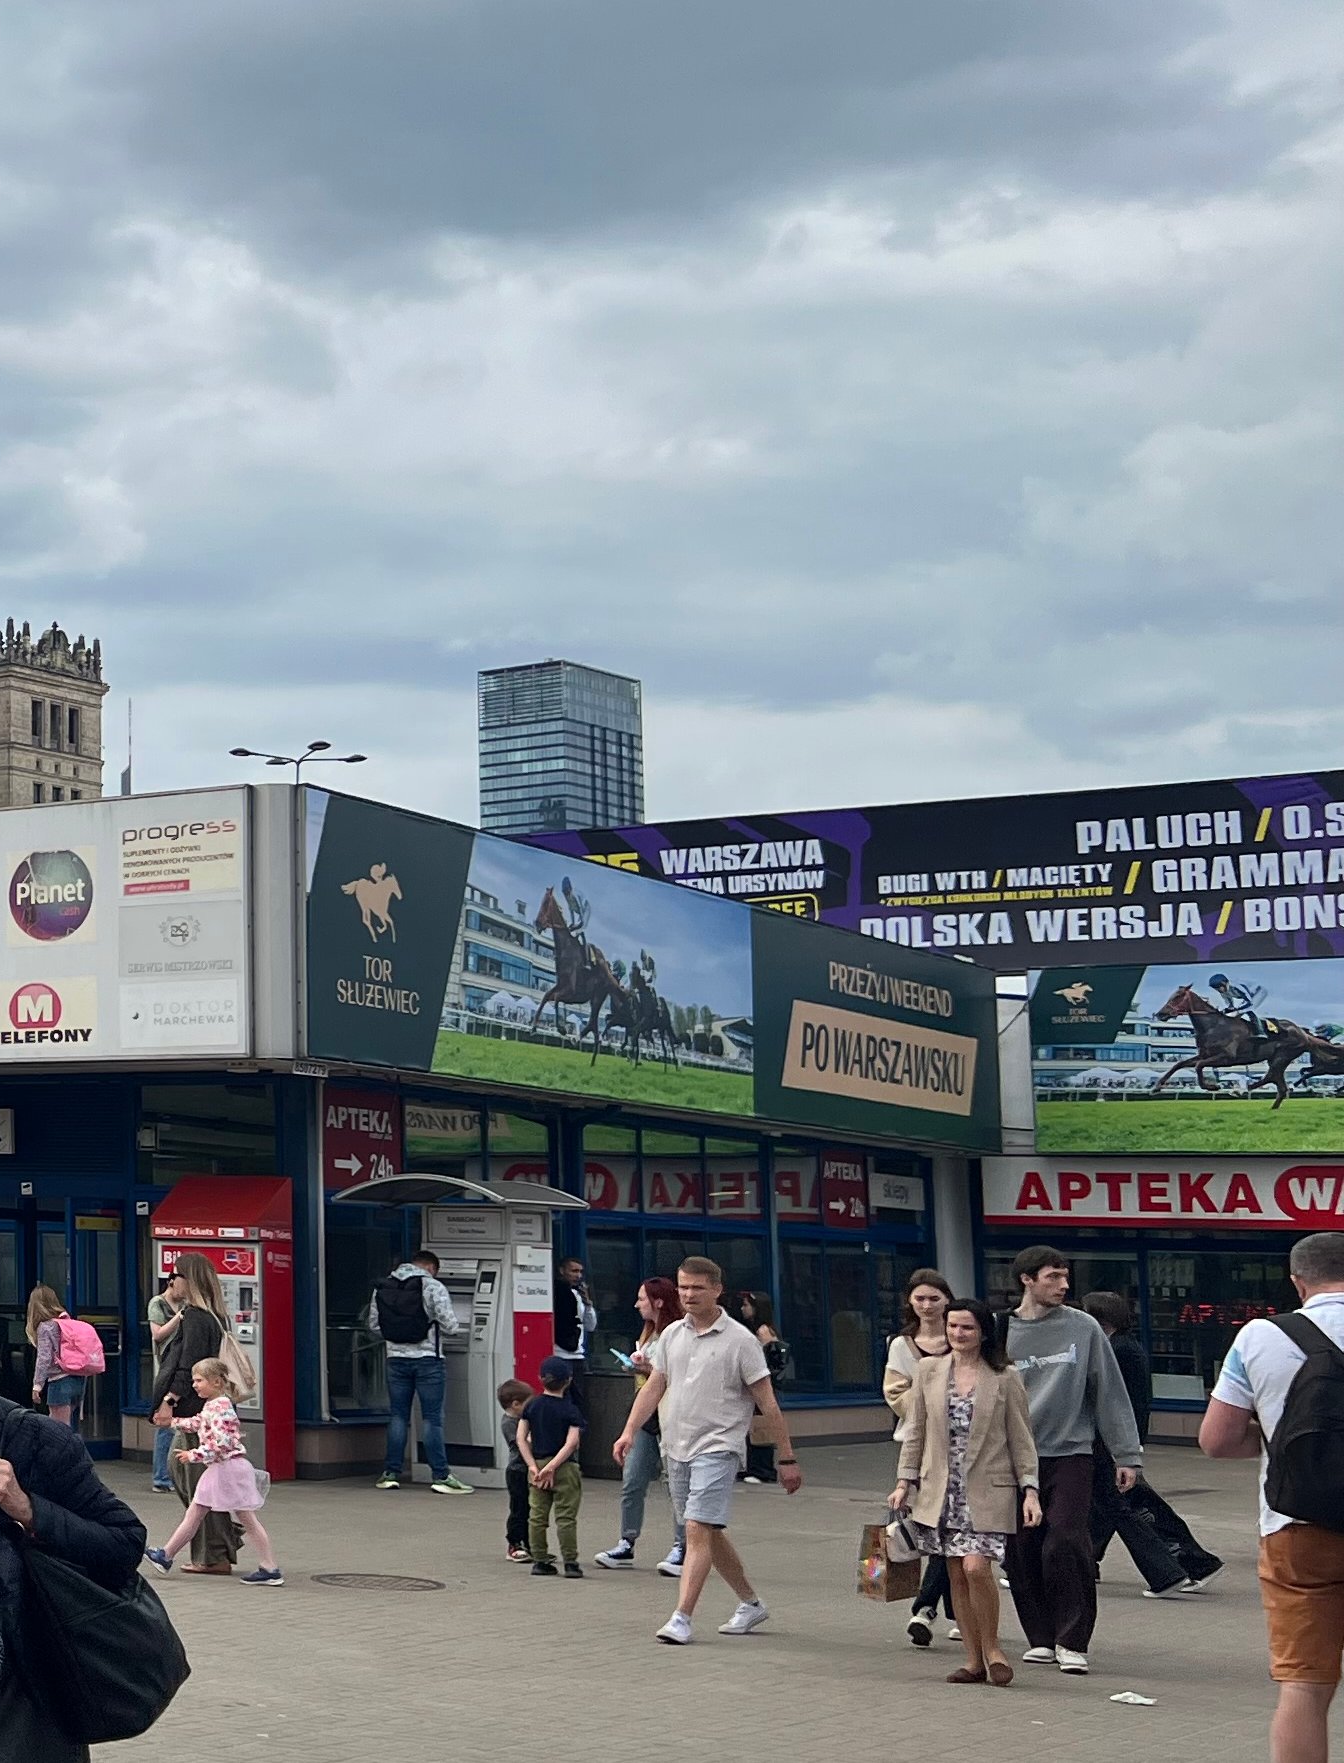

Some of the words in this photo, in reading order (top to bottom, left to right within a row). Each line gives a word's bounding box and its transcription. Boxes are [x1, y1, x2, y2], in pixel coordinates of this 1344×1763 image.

[121, 819, 237, 846] progress
[1076, 810, 1242, 854] PALUCH
[1254, 807, 1272, 842] /
[659, 838, 824, 875] WARSZAWA
[16, 878, 86, 906] Planet
[728, 868, 824, 894] URSYNÓW
[878, 873, 930, 894] BUGI
[935, 870, 987, 891] WTH
[1006, 863, 1112, 887] MACIĘTY
[60, 906, 81, 917] cash
[1025, 902, 1204, 943] WERSJA
[1243, 894, 1344, 934] BON
[128, 961, 162, 973] SERWIS
[164, 959, 233, 972] MISTRZOWSKI
[363, 955, 393, 983] TOR
[337, 978, 420, 1016] SŁUŻEWIEC
[828, 961, 889, 1003] PRZEŻYJ
[889, 976, 953, 1018] WEEKEND
[17, 994, 55, 1023] M
[152, 1000, 235, 1015] DOKTOR
[153, 1015, 236, 1027] MARCHEWKA
[801, 1022, 830, 1072] PO
[833, 1027, 966, 1097] WARSZAWSKU
[326, 1105, 393, 1134] APTEKA
[823, 1159, 863, 1182] APTEKA
[1015, 1171, 1263, 1214] APTEKA
[154, 1226, 179, 1237] Bilety
[184, 1227, 214, 1236] Tickets
